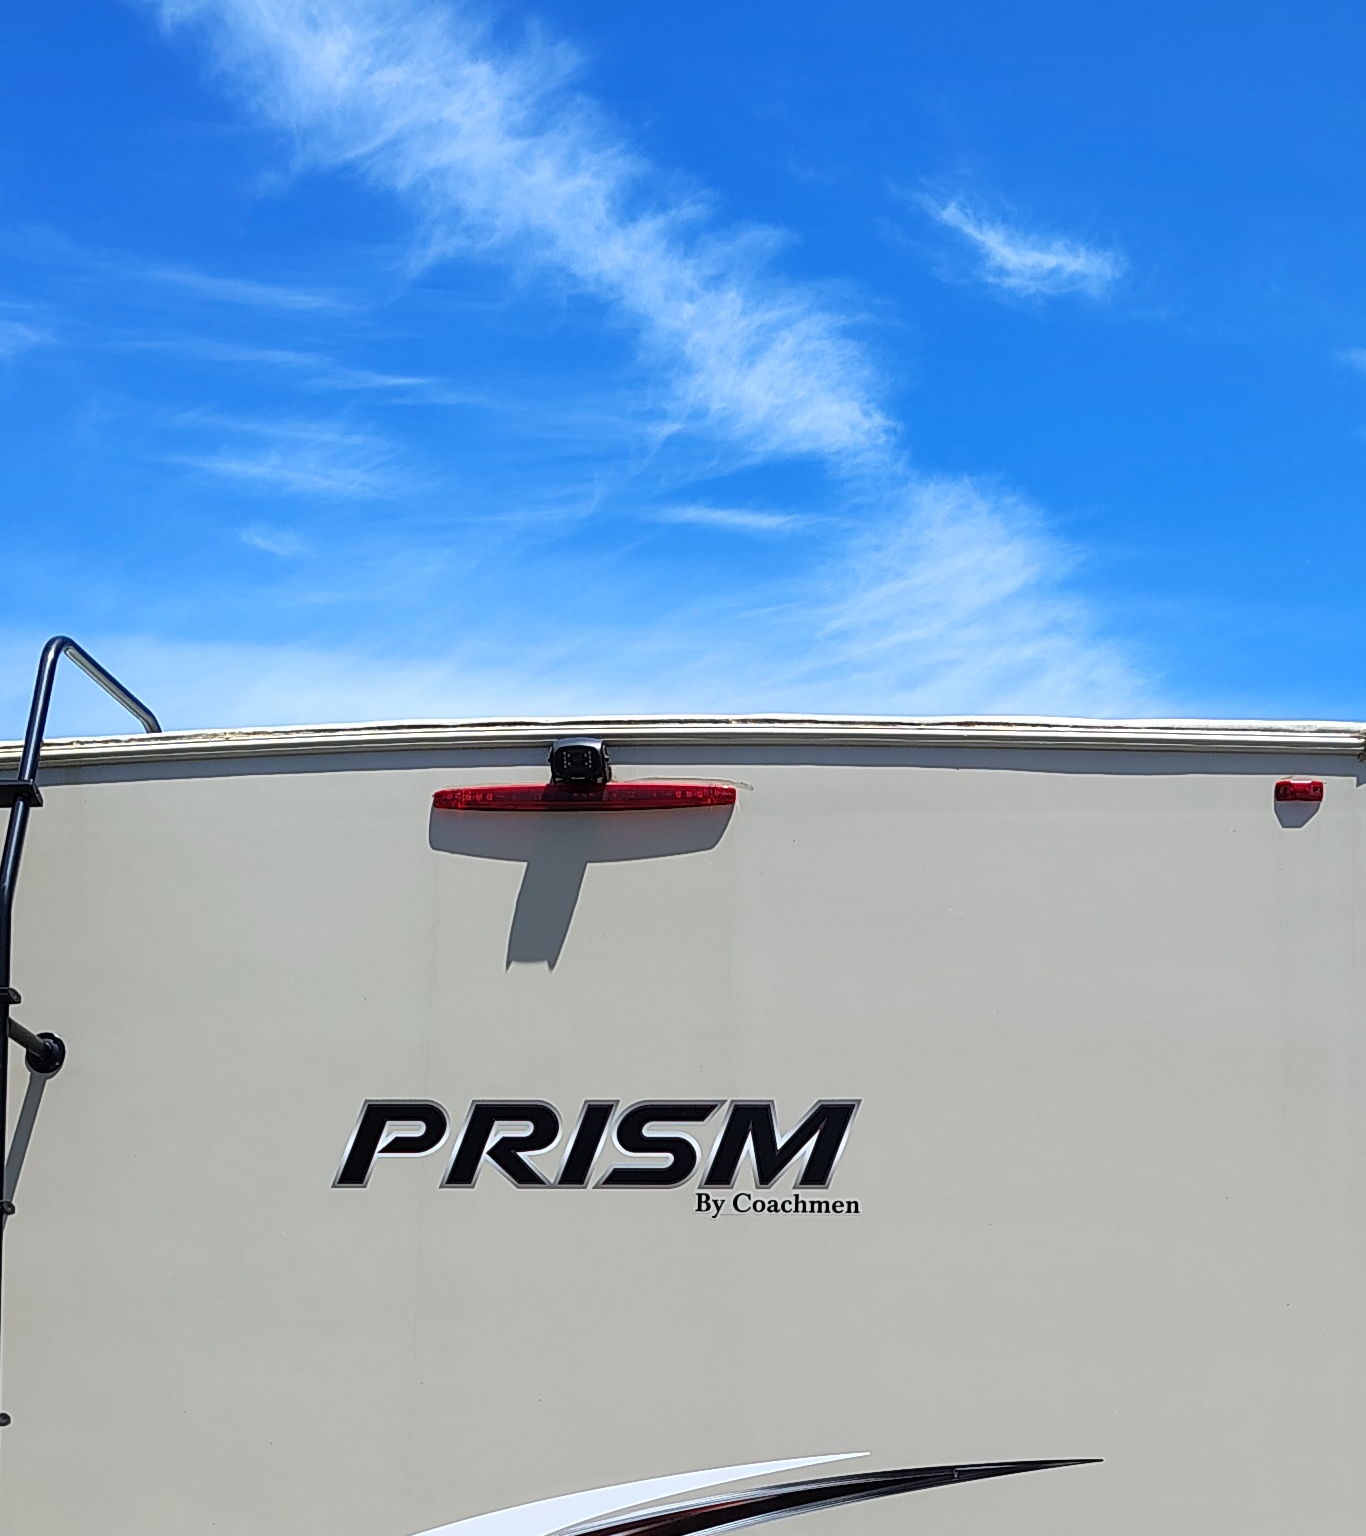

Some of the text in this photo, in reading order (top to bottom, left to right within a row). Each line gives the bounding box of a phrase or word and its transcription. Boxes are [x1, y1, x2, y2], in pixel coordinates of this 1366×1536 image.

[331, 1098, 863, 1190] PRISM
[695, 1192, 861, 1219] By Coachmen
